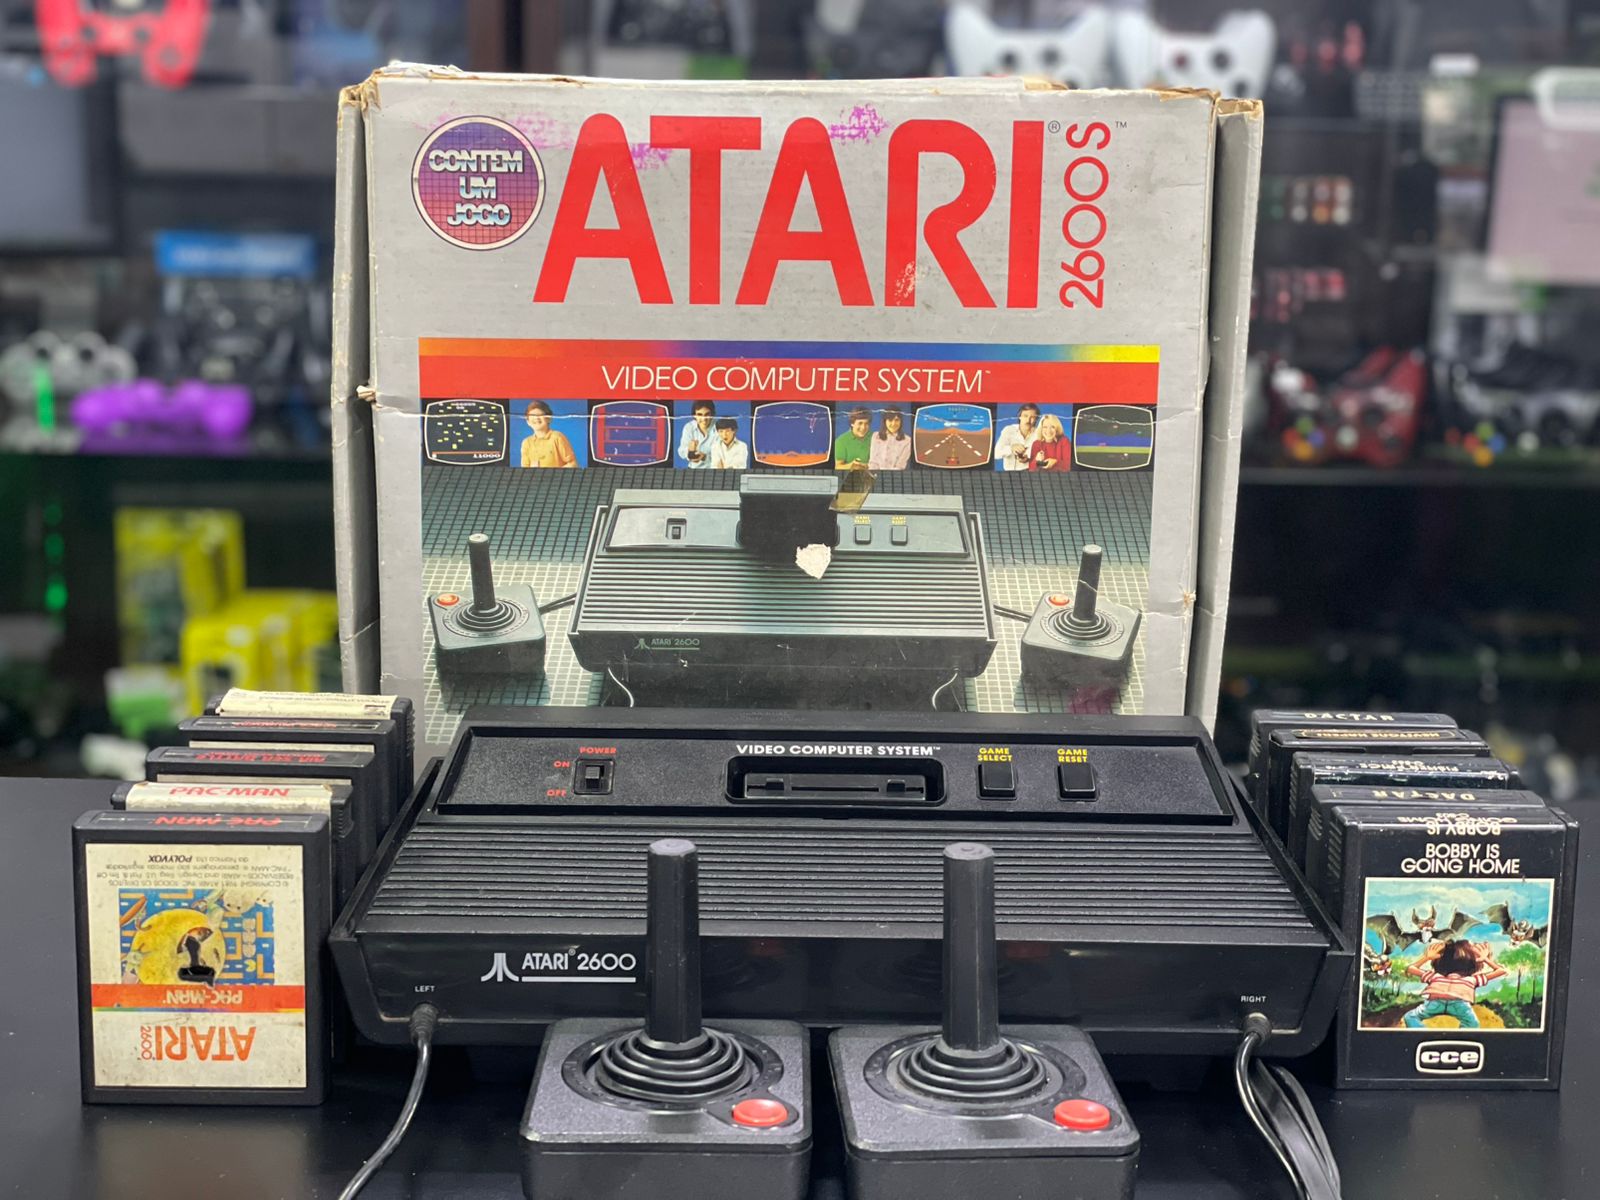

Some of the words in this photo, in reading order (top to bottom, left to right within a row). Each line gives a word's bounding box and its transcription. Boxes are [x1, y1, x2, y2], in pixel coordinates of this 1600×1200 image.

[459, 176, 498, 200] UM
[447, 202, 512, 227] JOGO
[533, 113, 1045, 309] ATARI
[1059, 121, 1111, 309] 2600S
[601, 365, 698, 391] VIDEO
[706, 366, 870, 392] COMPUTER
[877, 368, 984, 393] SYSTEM
[651, 638, 672, 646] ATARI
[675, 638, 700, 646] 2600
[579, 747, 617, 755] POWER
[736, 744, 785, 755] VIDEO
[789, 744, 873, 756] COMPUTER
[877, 745, 934, 756] SYSTEM
[978, 747, 1010, 755] GAME
[1057, 748, 1088, 756] GAME
[553, 760, 570, 768] ON
[977, 754, 1013, 762] SELECT
[1058, 755, 1088, 763] RESET
[169, 786, 290, 797] PAC-MAN
[546, 789, 567, 797] OFF
[154, 815, 282, 827] PAC-MAN
[1426, 820, 1440, 835] IS
[1446, 820, 1502, 835] BOBBY
[1425, 843, 1481, 859] BOBBY
[1486, 843, 1500, 858] IS
[148, 855, 193, 863] POLYVOX
[1400, 858, 1464, 874] GOING
[1468, 858, 1520, 874] HOME
[521, 953, 569, 970] ATARI
[577, 952, 637, 971] 2600
[1240, 995, 1267, 1003] RIGHT
[140, 1025, 152, 1061] 2600
[156, 1025, 257, 1061] ATARI
[1420, 1050, 1479, 1064] cce
